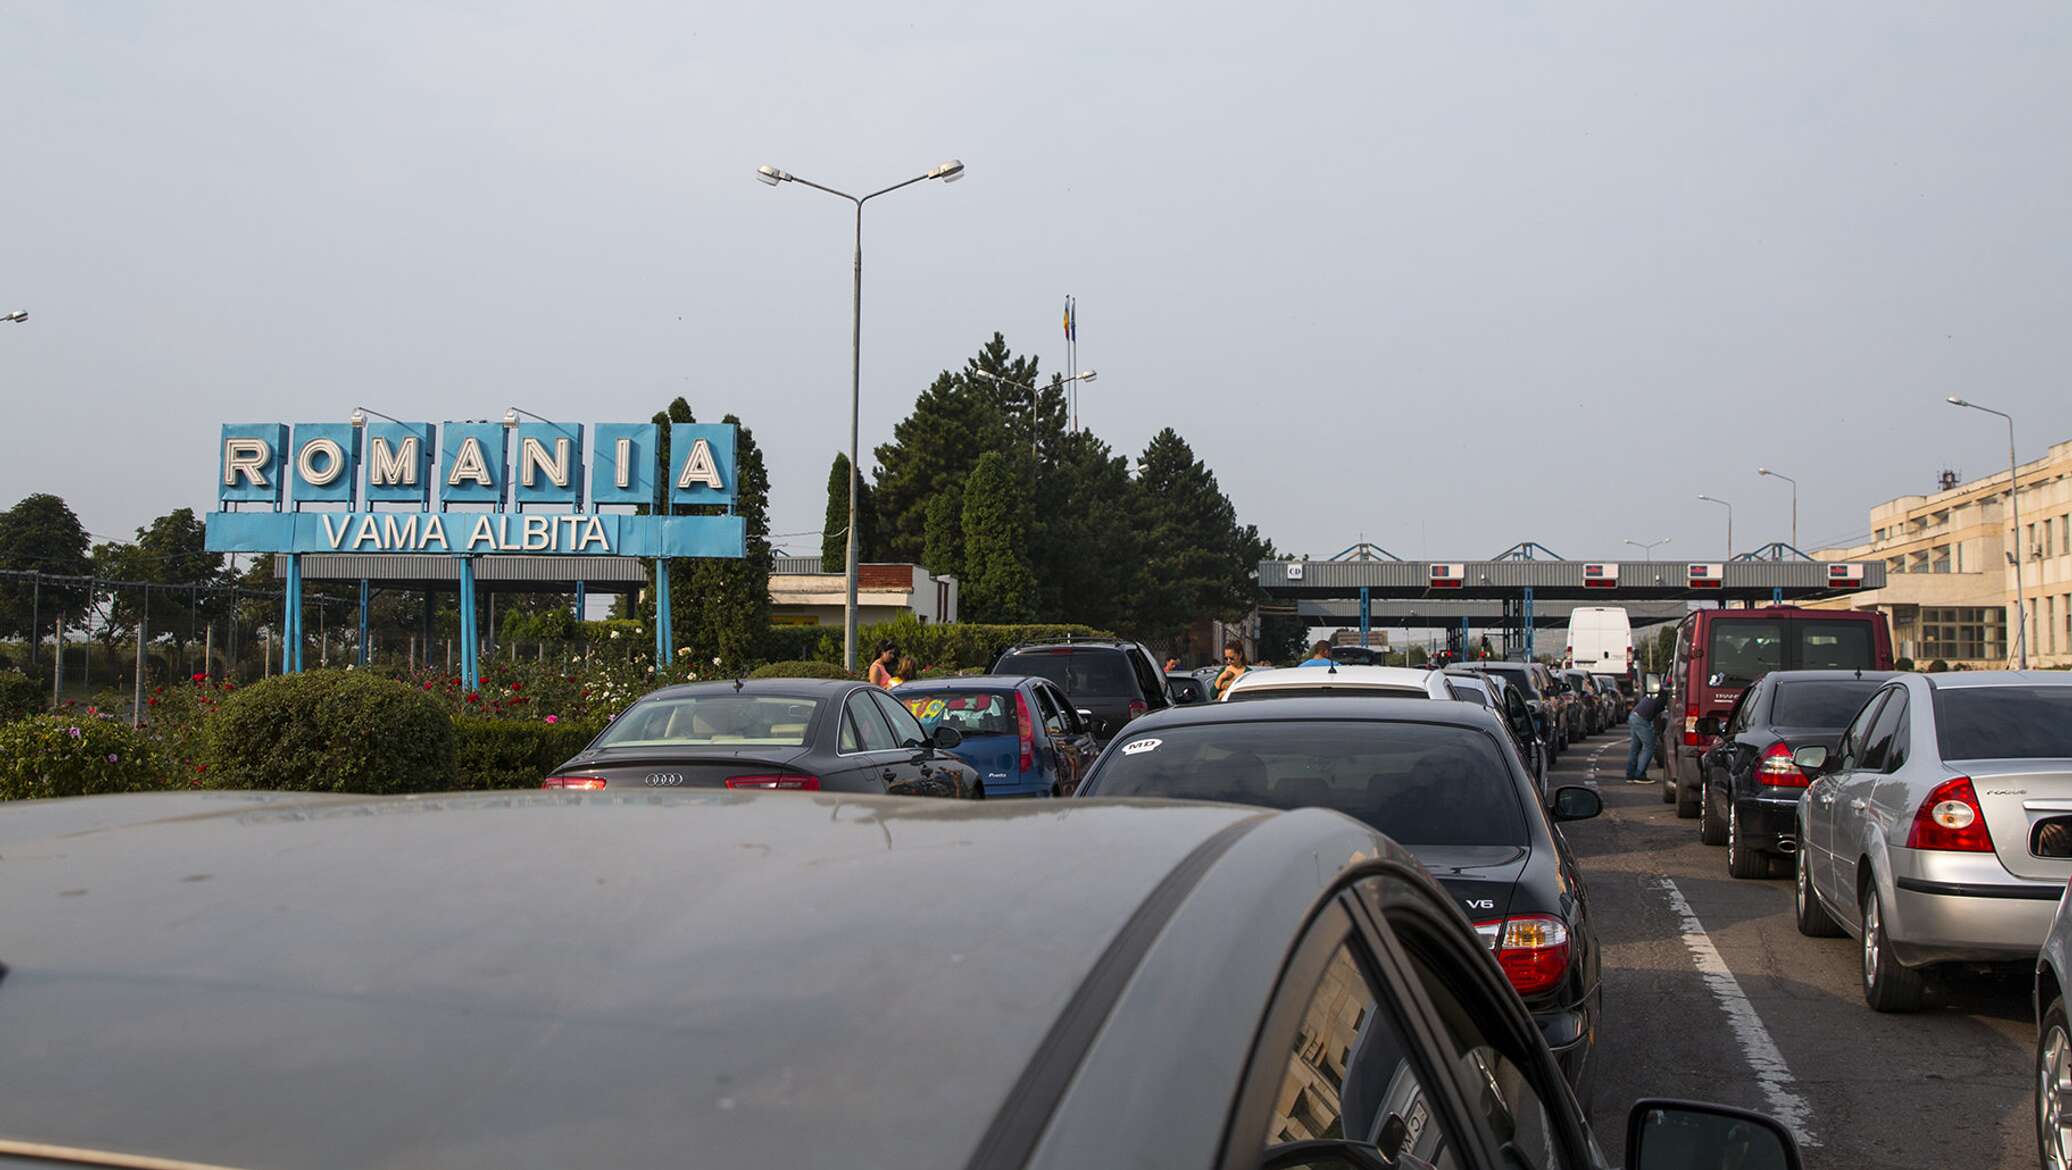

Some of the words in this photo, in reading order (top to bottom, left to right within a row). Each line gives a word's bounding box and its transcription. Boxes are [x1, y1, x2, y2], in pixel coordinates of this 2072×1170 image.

[224, 436, 724, 489] ROMANIA
[321, 514, 449, 549] VAMA
[467, 514, 610, 551] ALBITA
[1128, 740, 1156, 750] MD
[1465, 899, 1494, 909] V6
